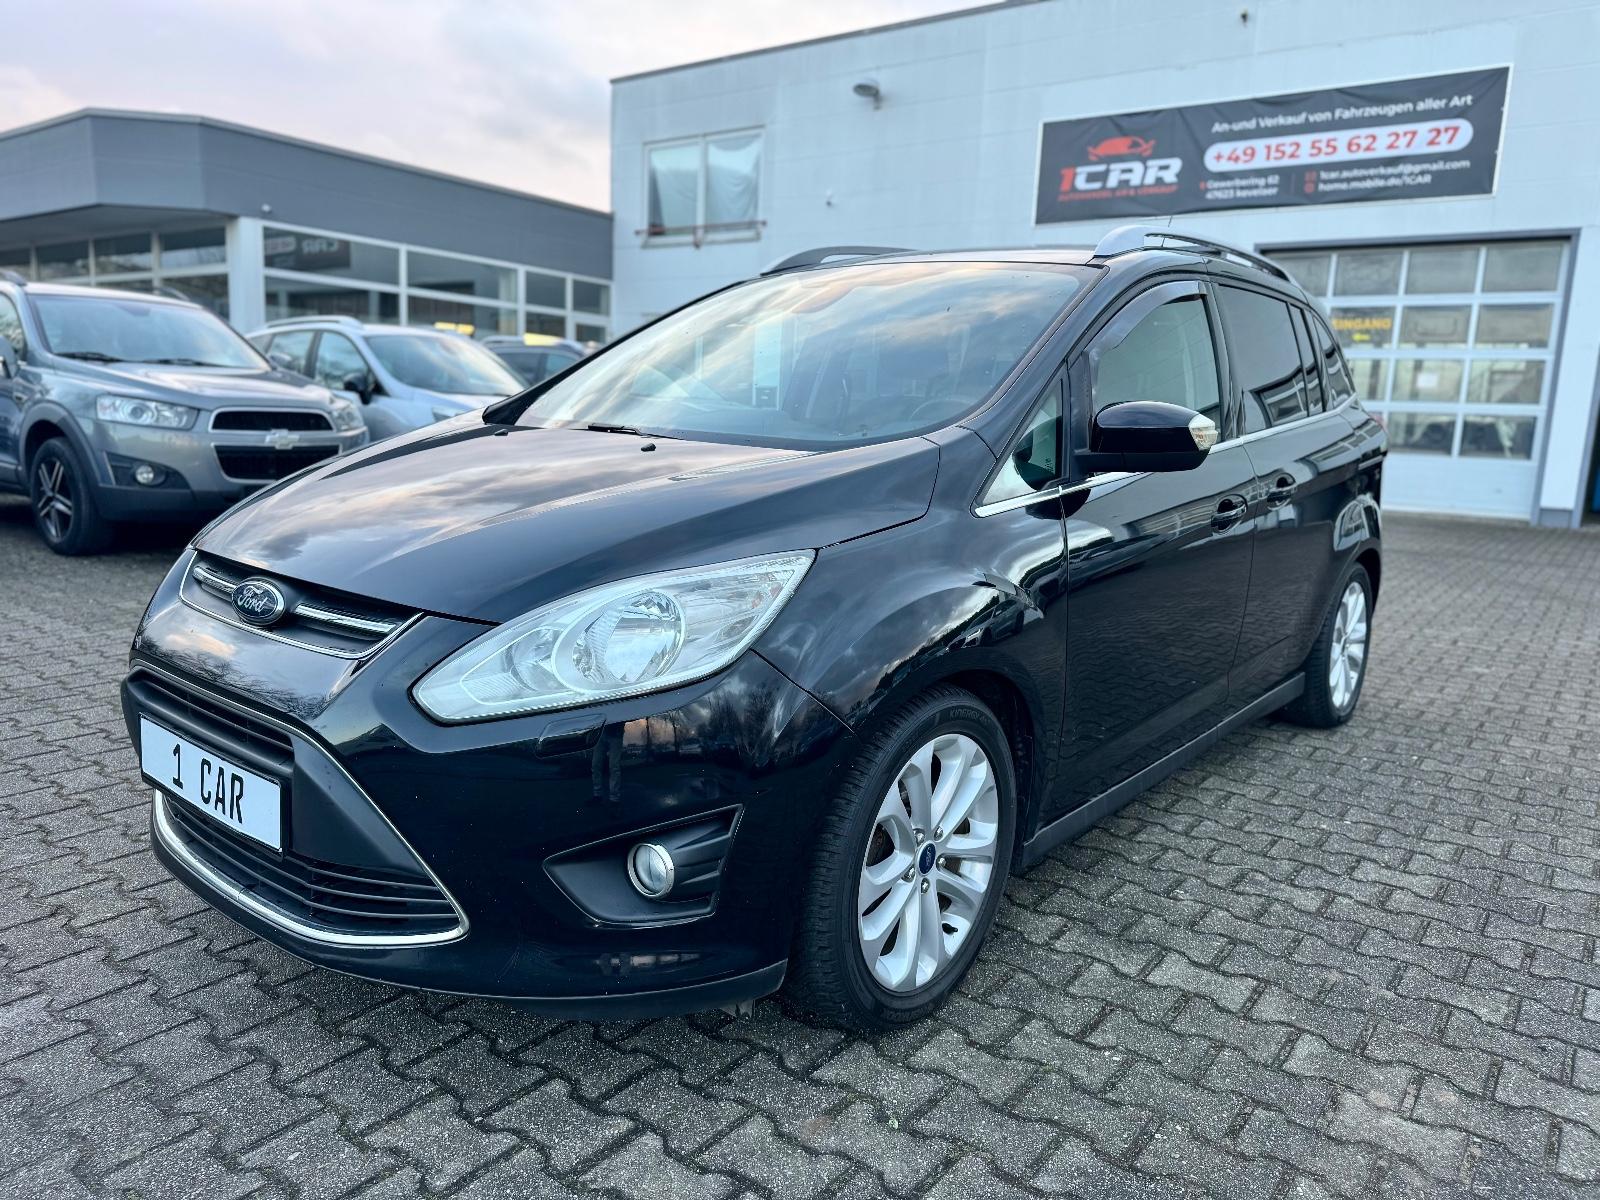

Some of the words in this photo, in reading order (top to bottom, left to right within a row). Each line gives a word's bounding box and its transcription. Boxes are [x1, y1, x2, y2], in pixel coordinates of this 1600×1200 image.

[1258, 112, 1308, 129] Verkauf
[1308, 112, 1332, 123] von
[1334, 105, 1414, 120] Fahrzeugen
[1416, 97, 1447, 111] aller
[1450, 95, 1473, 108] Art
[1213, 145, 1257, 164] +49
[1264, 141, 1301, 161] 152
[1309, 138, 1338, 157] 55
[1347, 134, 1377, 153] 62
[1386, 130, 1418, 149] 27
[1426, 126, 1460, 146] 27
[1060, 157, 1183, 192] 1CAR
[238, 585, 269, 612] Ford
[172, 743, 184, 790] 1
[200, 757, 244, 824] CAR
